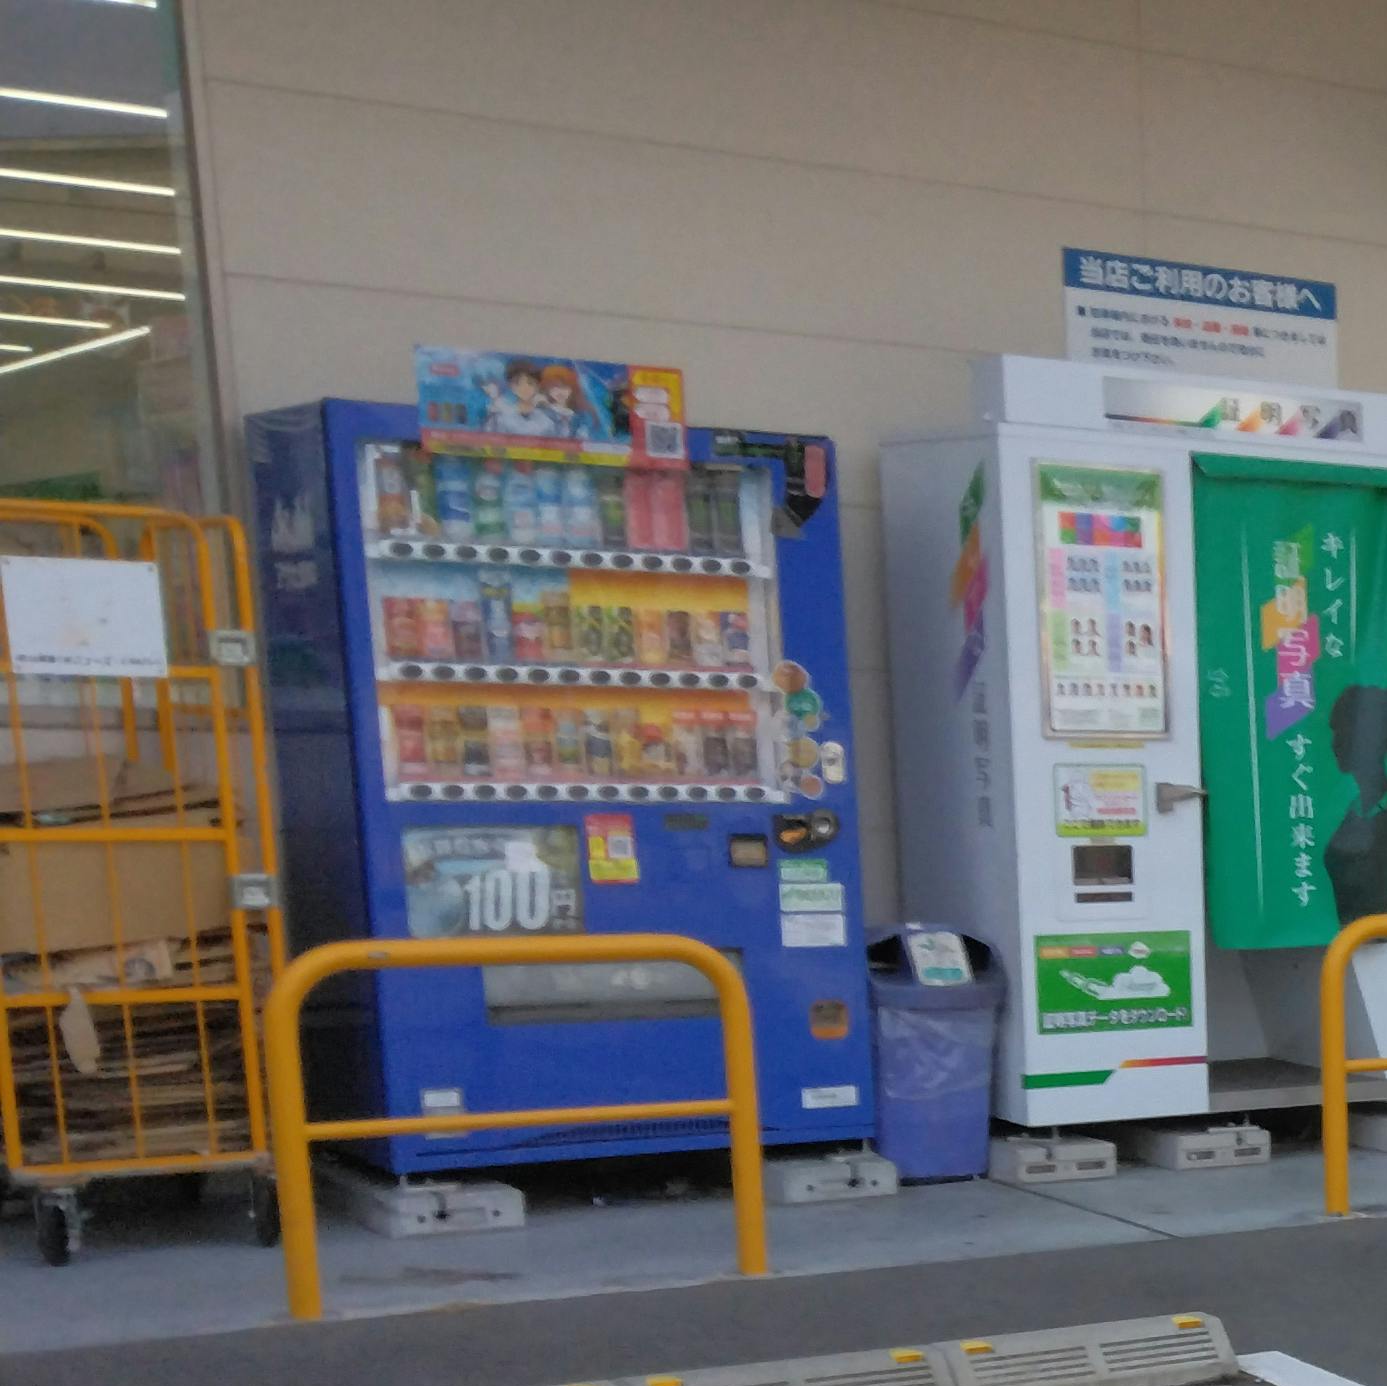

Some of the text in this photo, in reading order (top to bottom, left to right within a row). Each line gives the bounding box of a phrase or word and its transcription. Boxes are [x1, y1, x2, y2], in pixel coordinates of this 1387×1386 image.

[1079, 256, 1322, 312] 当店ご利用のお客様へ
[1272, 540, 1316, 709] 証明写真
[1320, 532, 1345, 657] キレイな
[1285, 733, 1318, 907] すぐ出来ます
